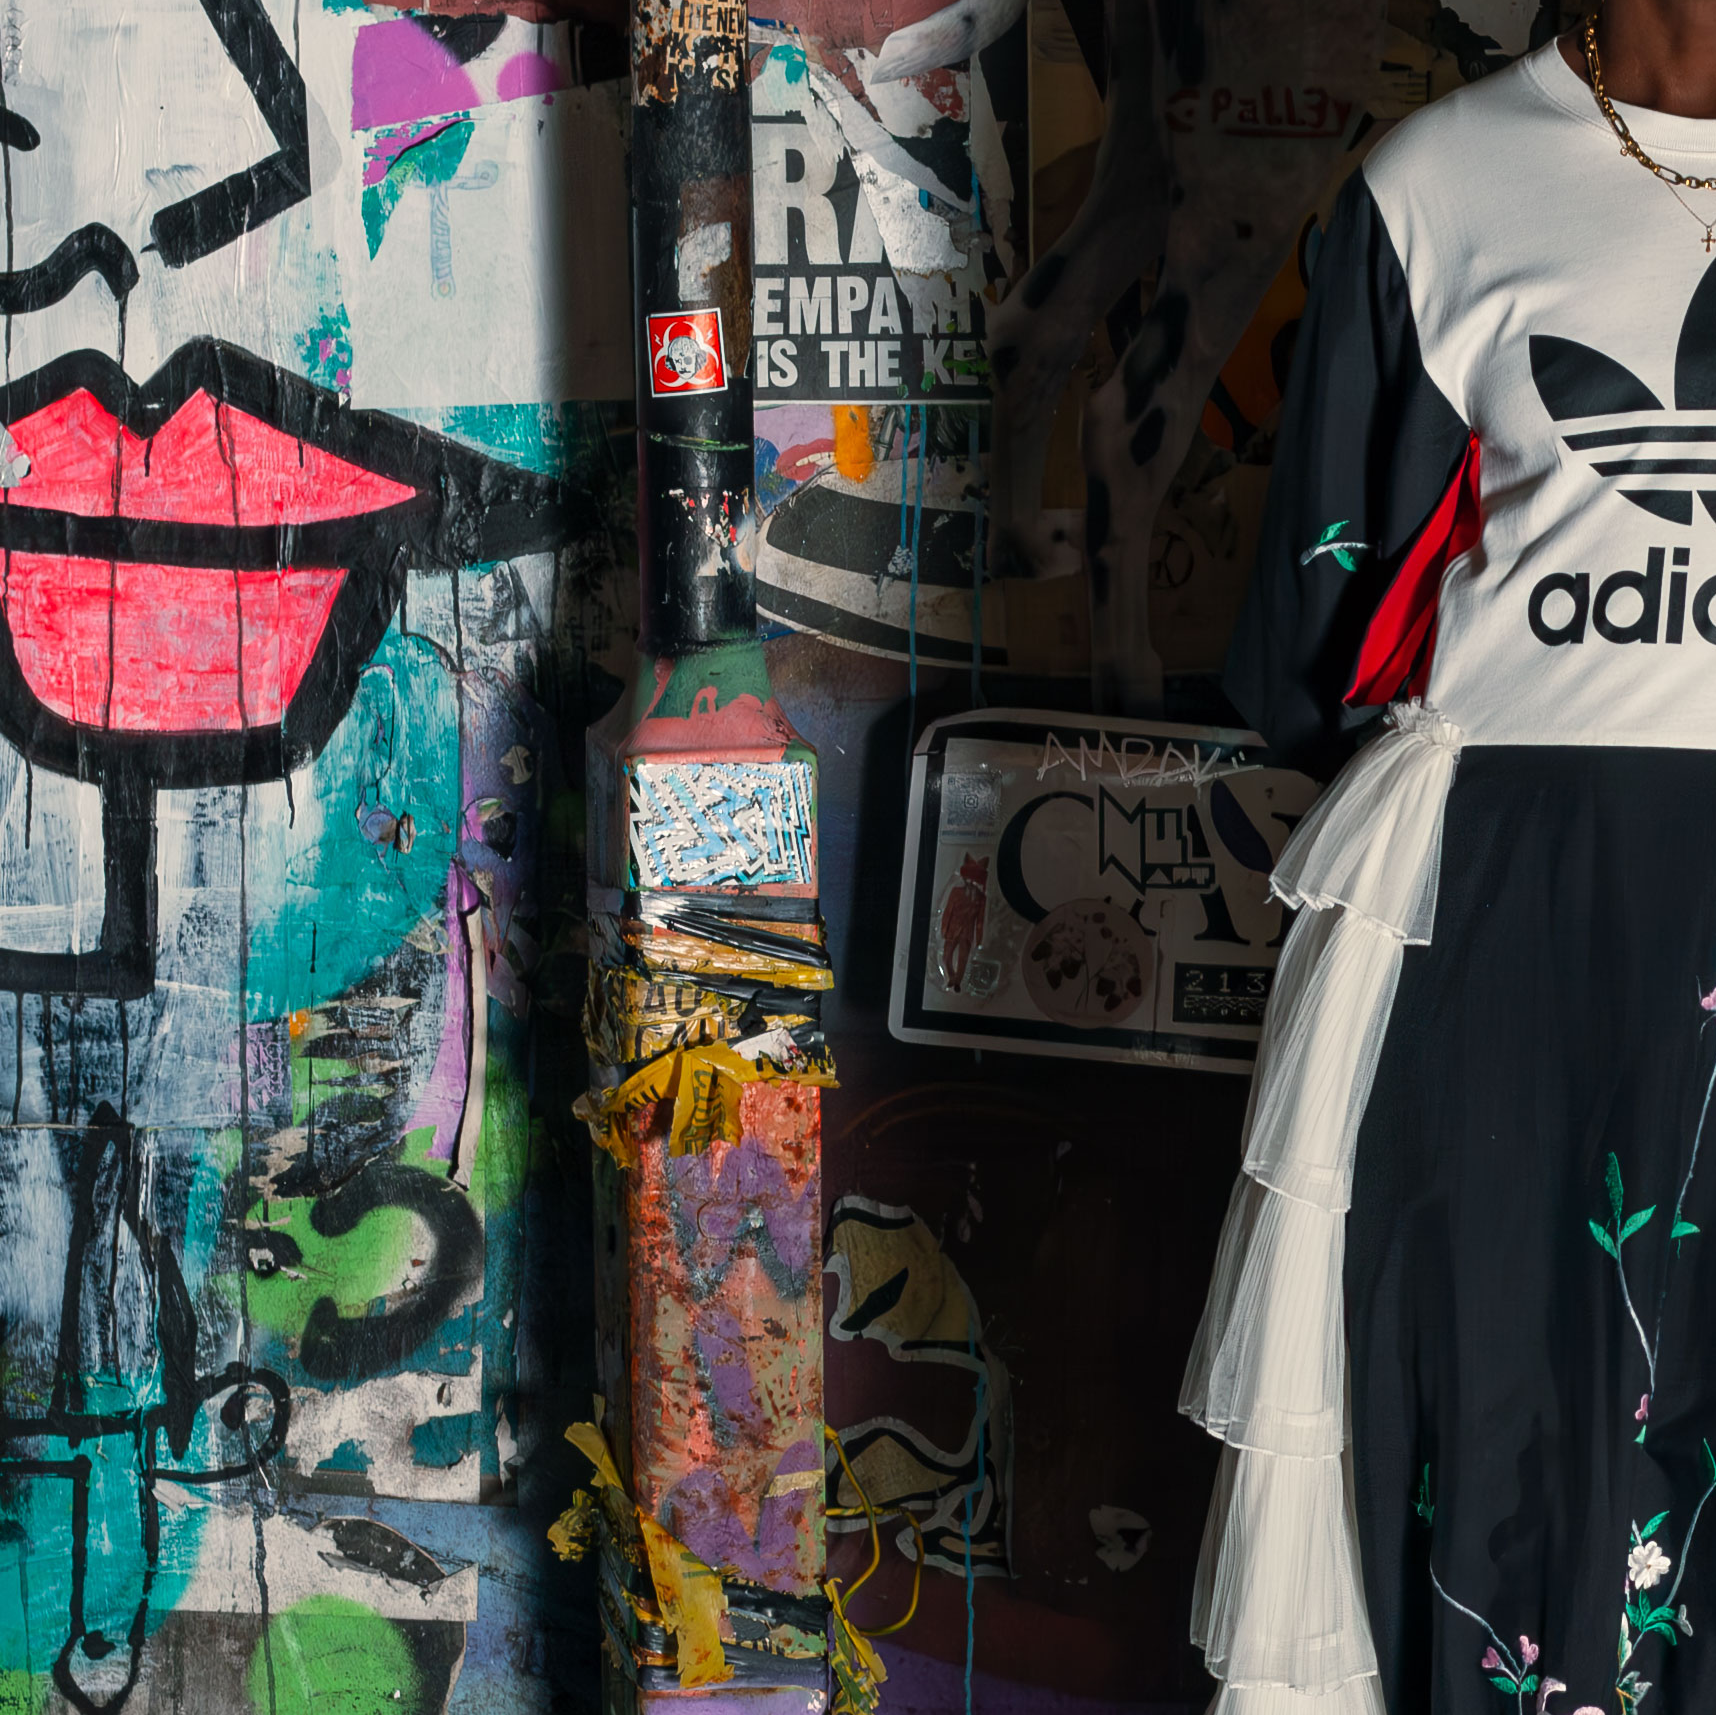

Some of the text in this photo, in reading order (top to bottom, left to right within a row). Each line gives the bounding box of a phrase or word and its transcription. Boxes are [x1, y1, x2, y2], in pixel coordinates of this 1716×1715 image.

[755, 339, 992, 390] IS THE KE
